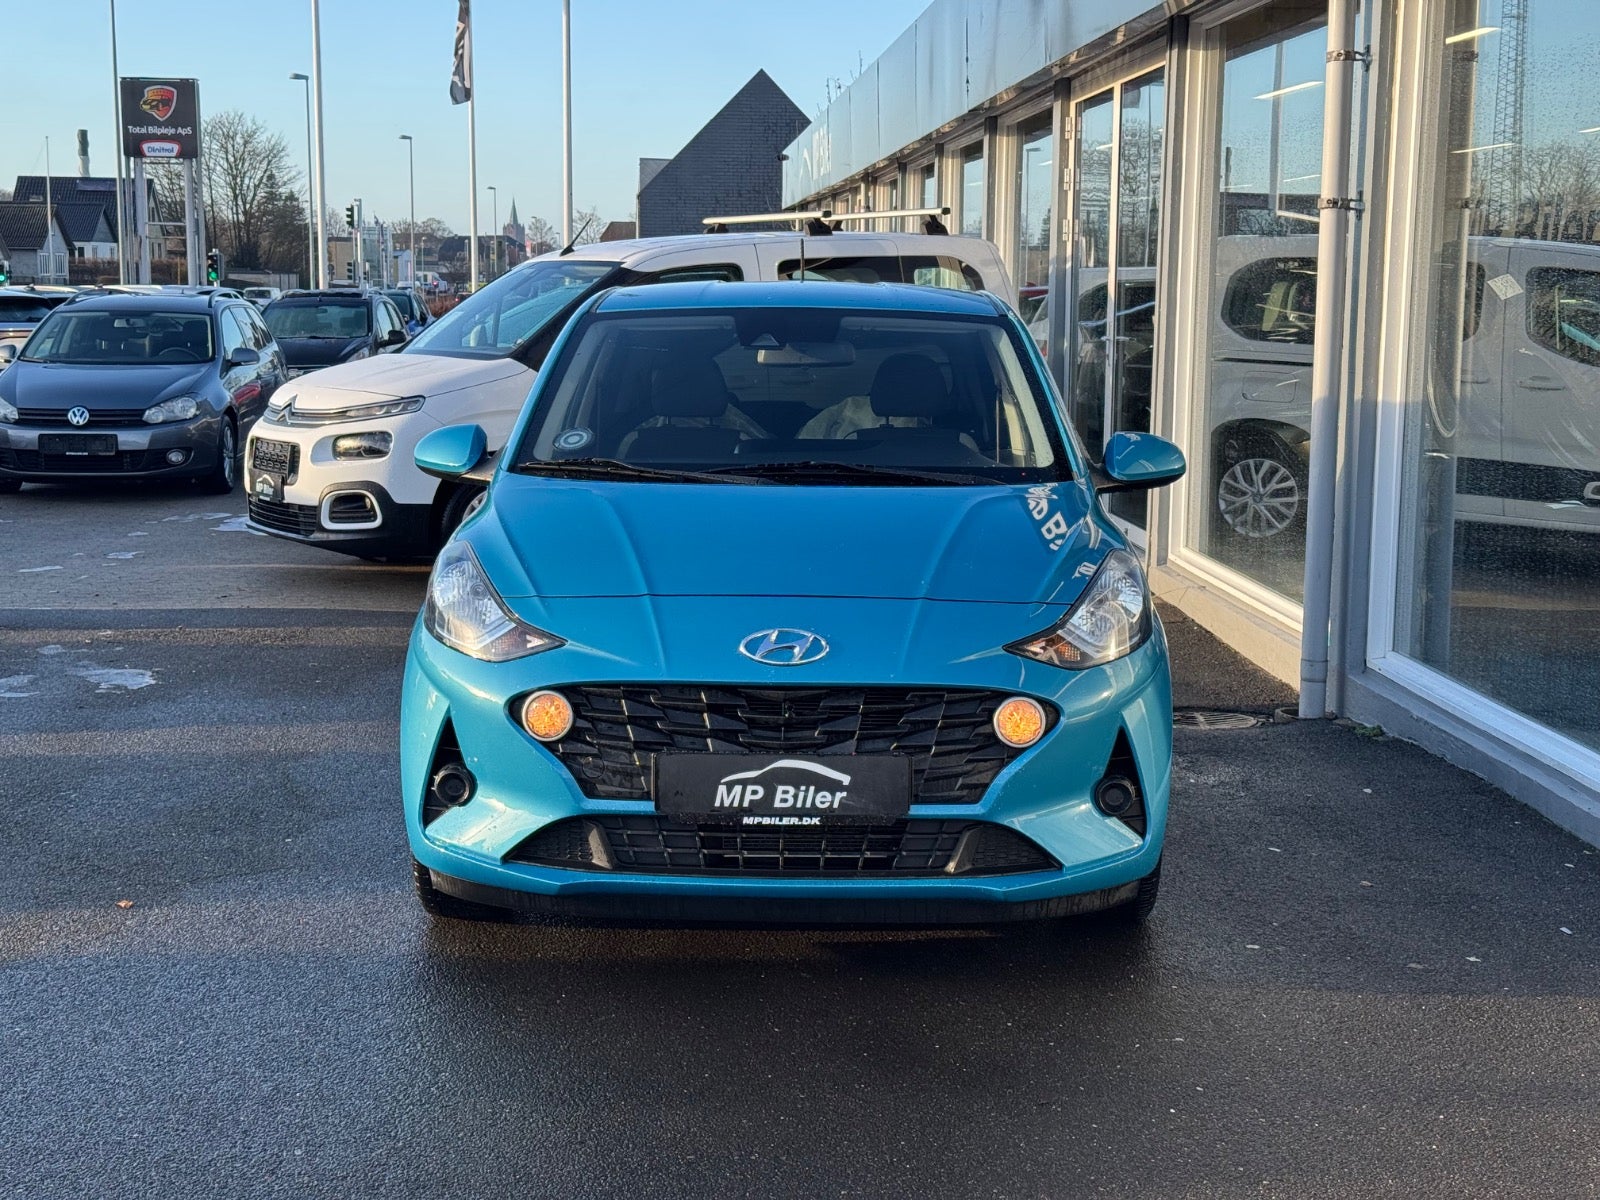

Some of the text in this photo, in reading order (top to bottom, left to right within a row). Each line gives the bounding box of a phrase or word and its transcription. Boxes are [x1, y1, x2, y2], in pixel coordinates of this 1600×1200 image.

[128, 125, 193, 136] Total Bilpleje ApS
[147, 145, 175, 154] Dinitrol
[714, 784, 848, 809] MP Biler
[742, 816, 822, 826] MPBILER.DK
